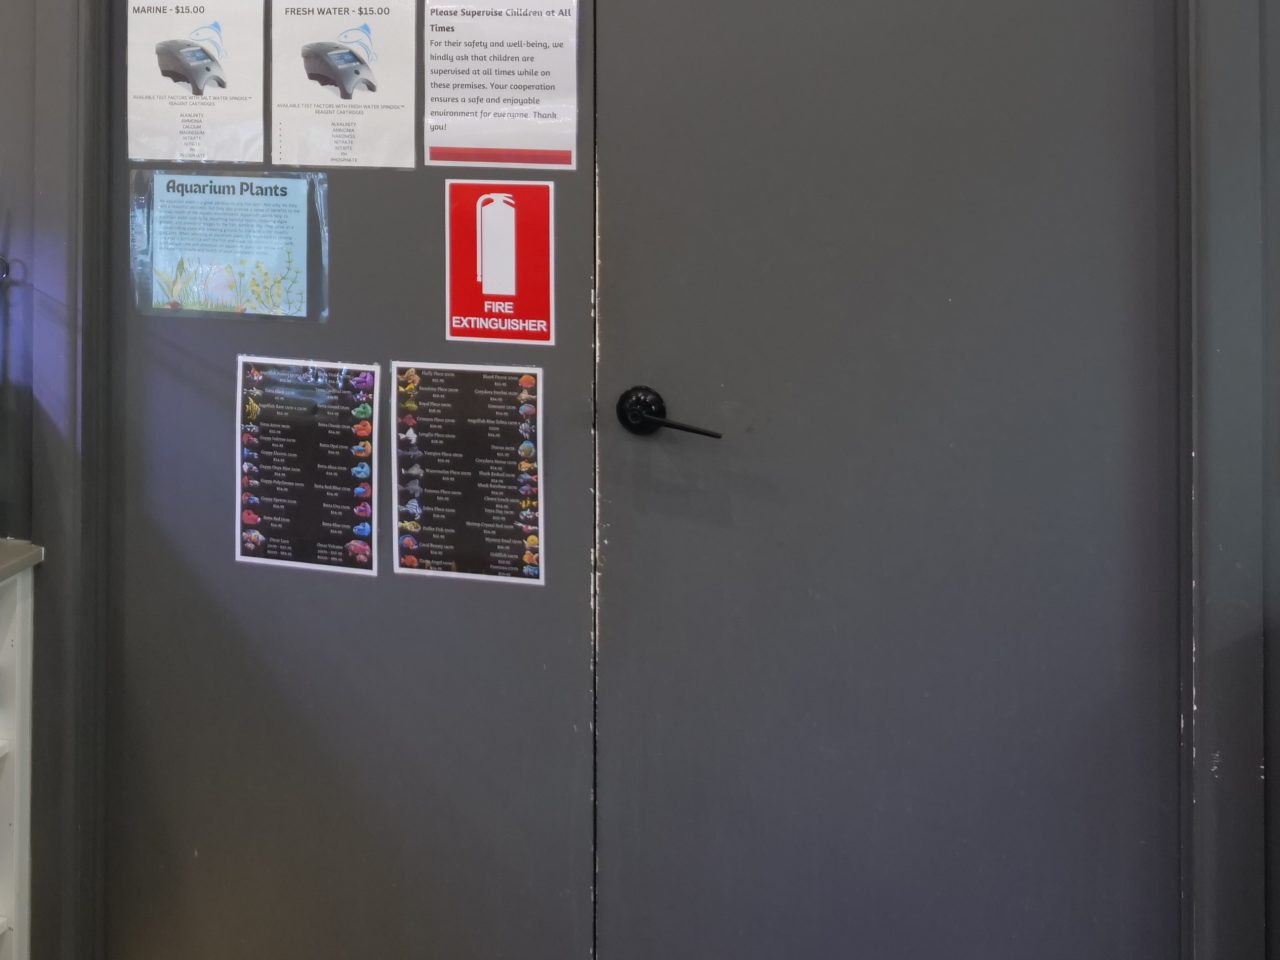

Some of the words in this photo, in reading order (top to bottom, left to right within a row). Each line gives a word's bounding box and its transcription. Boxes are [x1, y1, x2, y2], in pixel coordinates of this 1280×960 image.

[132, 5, 168, 14] MARINE
[174, 5, 205, 14] $15.00
[284, 7, 315, 16] FRESH
[317, 7, 350, 16] WATER
[358, 7, 390, 16] $15.00
[430, 8, 458, 17] Please
[461, 8, 503, 19] Supervise
[546, 9, 555, 17] at
[558, 8, 571, 17] All
[430, 24, 455, 32] Times
[464, 40, 488, 49] safety
[490, 40, 504, 48] and
[506, 40, 550, 49] well-being,
[430, 54, 454, 62] kindly
[489, 54, 520, 62] children
[430, 68, 470, 76] supervised
[472, 68, 480, 76] at
[482, 68, 492, 76] all
[494, 68, 515, 76] times
[430, 81, 450, 89] these
[452, 82, 487, 91] premises.
[490, 82, 507, 90] Your
[510, 83, 555, 91] cooperation
[468, 96, 484, 104] safe
[486, 96, 500, 104] and
[503, 97, 540, 106] enjoyable
[430, 110, 477, 118] environment
[480, 110, 491, 118] for
[533, 111, 557, 119] Thank
[166, 179, 236, 197] Aquarium
[240, 181, 288, 197] Plants
[484, 300, 514, 313] FIRE
[452, 316, 548, 332] EXTINGUISHER
